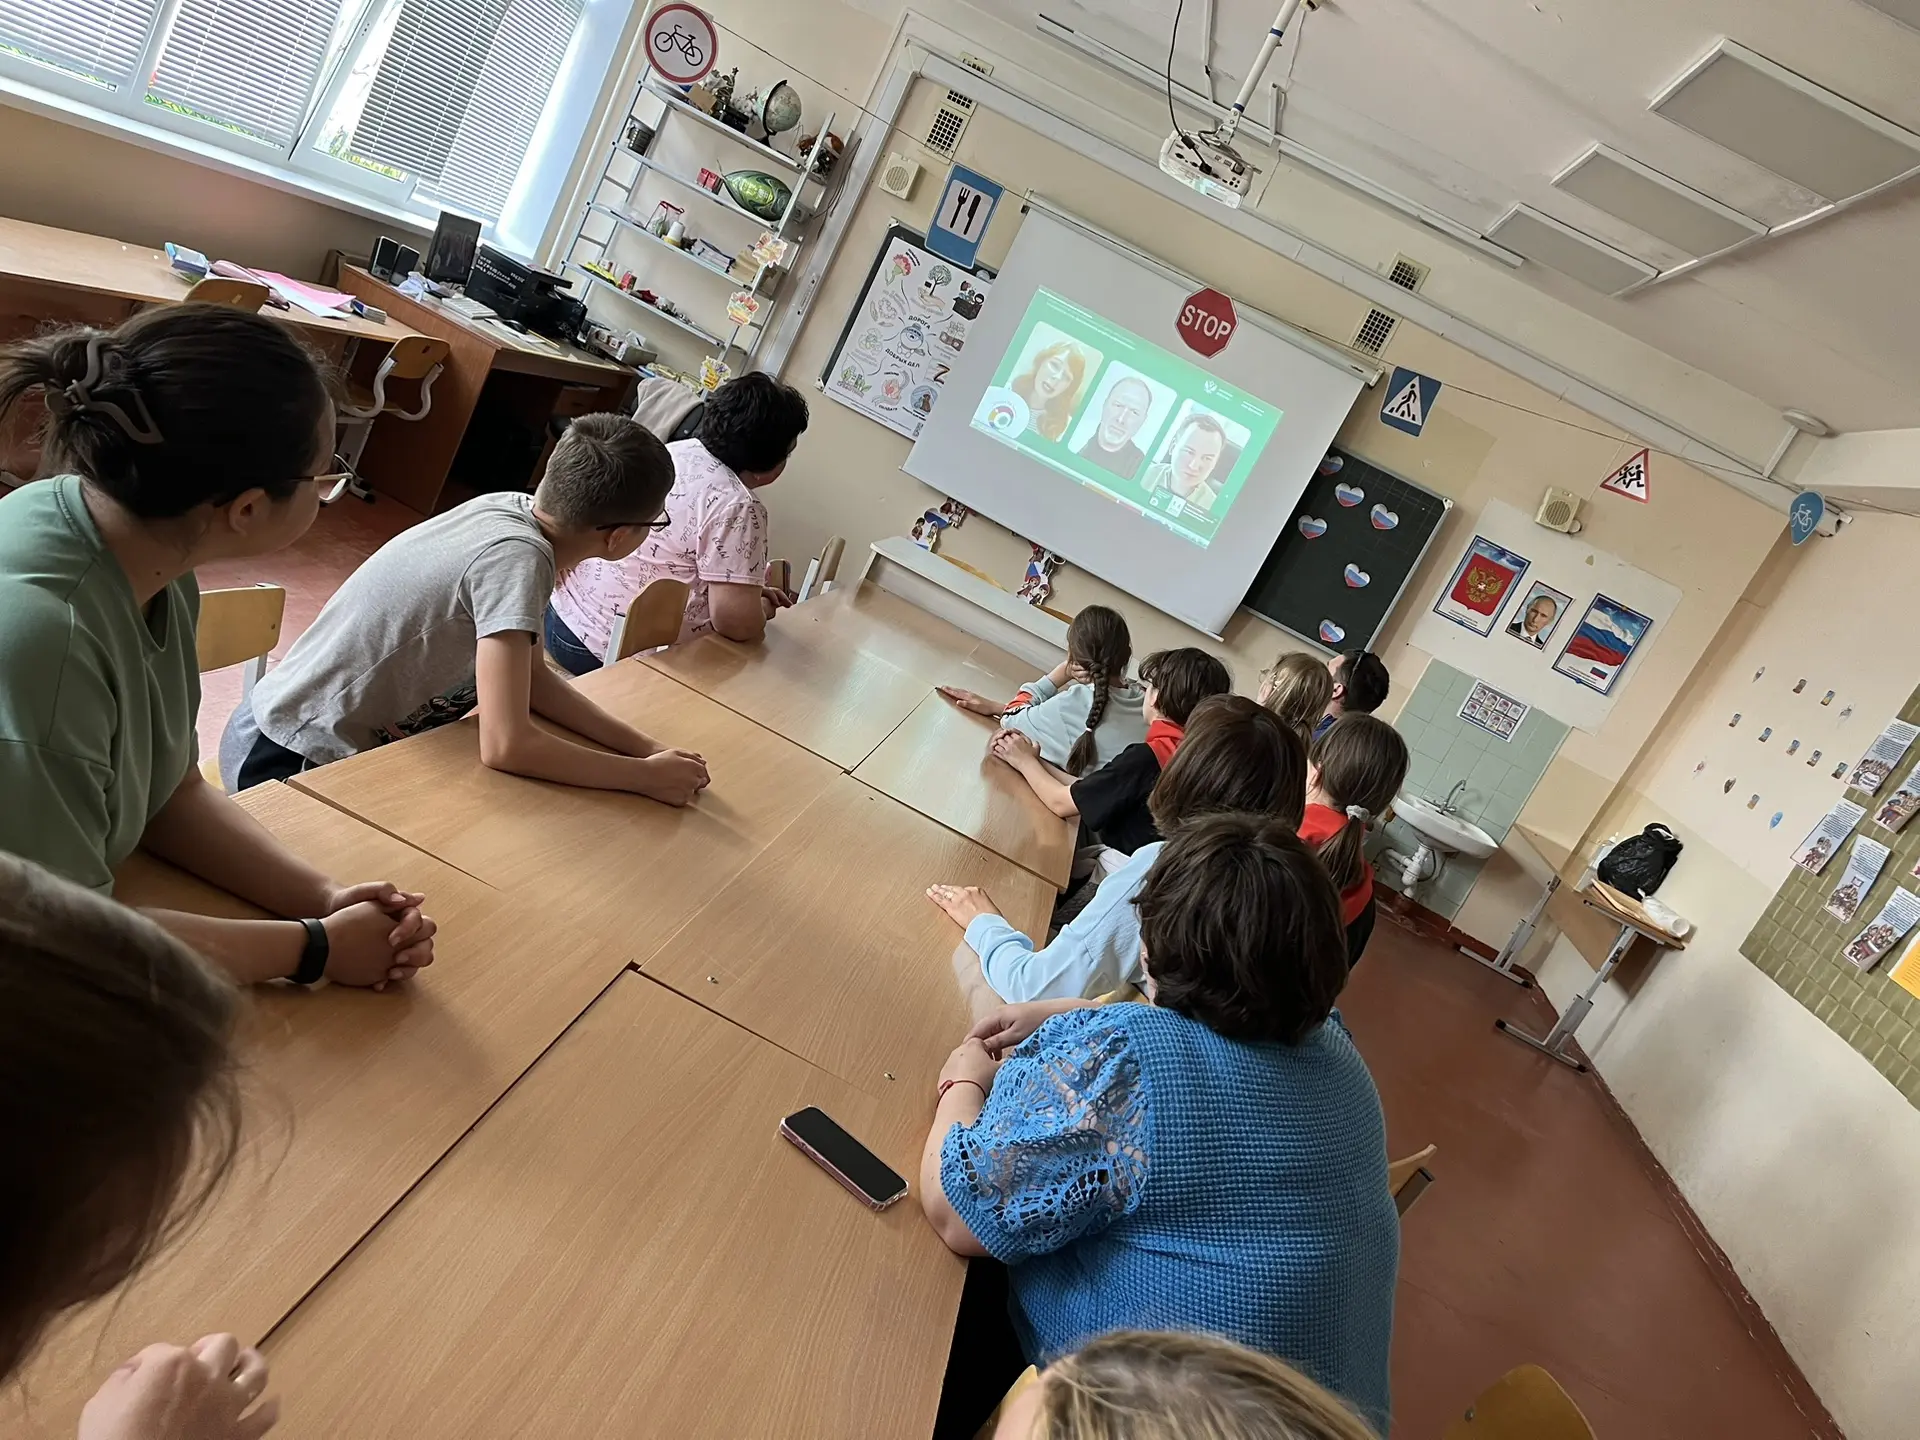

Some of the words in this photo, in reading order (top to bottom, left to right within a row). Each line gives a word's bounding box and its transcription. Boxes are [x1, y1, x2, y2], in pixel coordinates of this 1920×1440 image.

[908, 315, 931, 329] ДОРОГА
[1181, 304, 1231, 340] STOP
[885, 348, 907, 364] ДОБРЫХ
[907, 360, 920, 368] ДЕЛ
